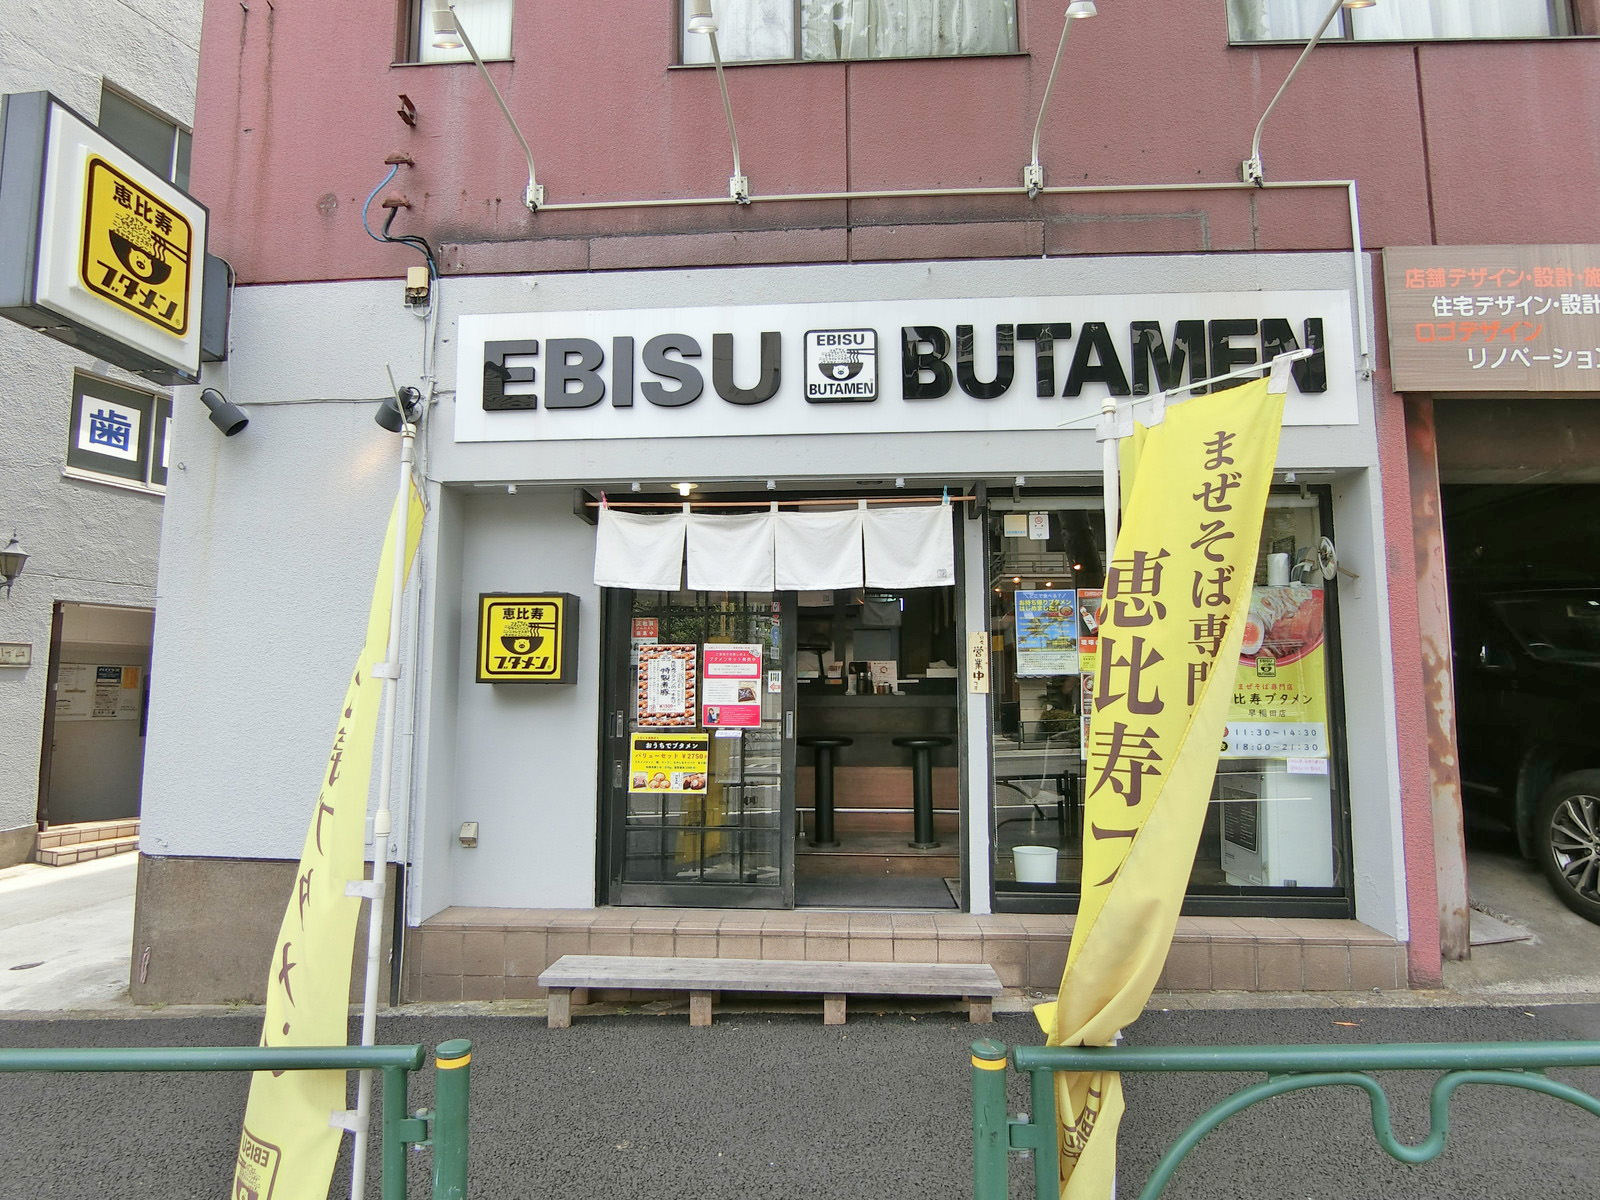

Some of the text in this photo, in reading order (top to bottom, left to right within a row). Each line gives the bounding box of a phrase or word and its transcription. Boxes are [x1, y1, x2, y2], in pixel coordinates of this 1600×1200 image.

[113, 180, 173, 236] 恵比寿
[97, 259, 178, 321] ブタメン
[1432, 293, 1600, 317] 住宅デザイン・設計
[816, 333, 865, 346] EBISU
[1415, 321, 1544, 343] ロゴデザイン
[483, 317, 1327, 411] EBISU BUTAMEN
[1468, 347, 1600, 370] リノベーショ
[809, 382, 873, 395] BUTAMEN
[90, 409, 132, 452] 歯
[502, 607, 544, 620] 恵比寿
[494, 656, 550, 669] ブタメン
[1237, 683, 1293, 691] まぜそば専門店
[1248, 708, 1287, 718] 早稲田店
